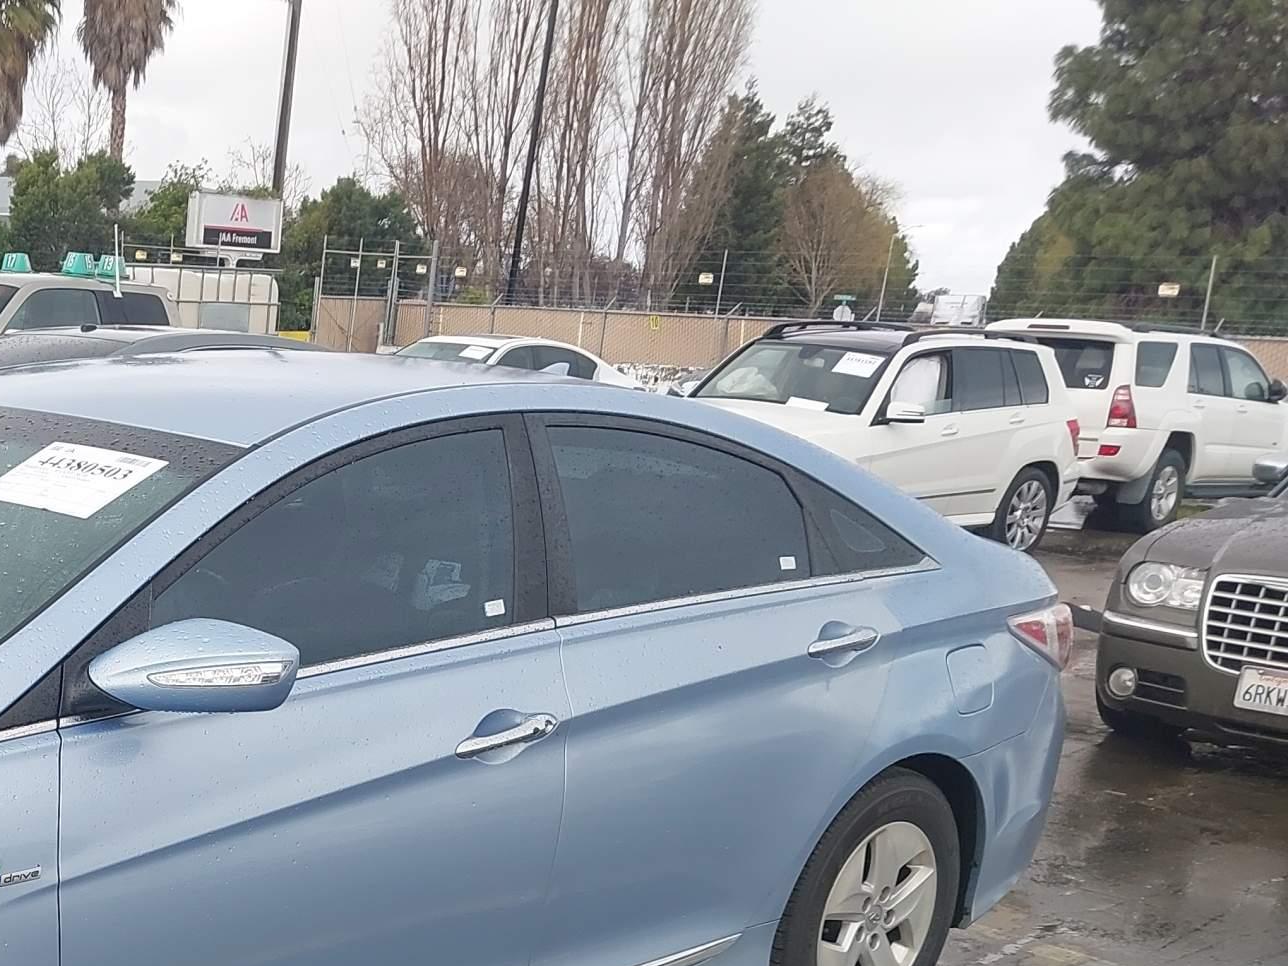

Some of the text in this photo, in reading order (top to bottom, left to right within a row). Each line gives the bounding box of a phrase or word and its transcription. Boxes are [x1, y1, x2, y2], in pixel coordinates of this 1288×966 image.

[232, 233, 257, 244] Fremont
[7, 254, 17, 268] 17
[103, 256, 114, 271] 13
[38, 455, 133, 480] 44380503
[1242, 683, 1288, 707] 6RKW
[3, 869, 40, 884] drive
